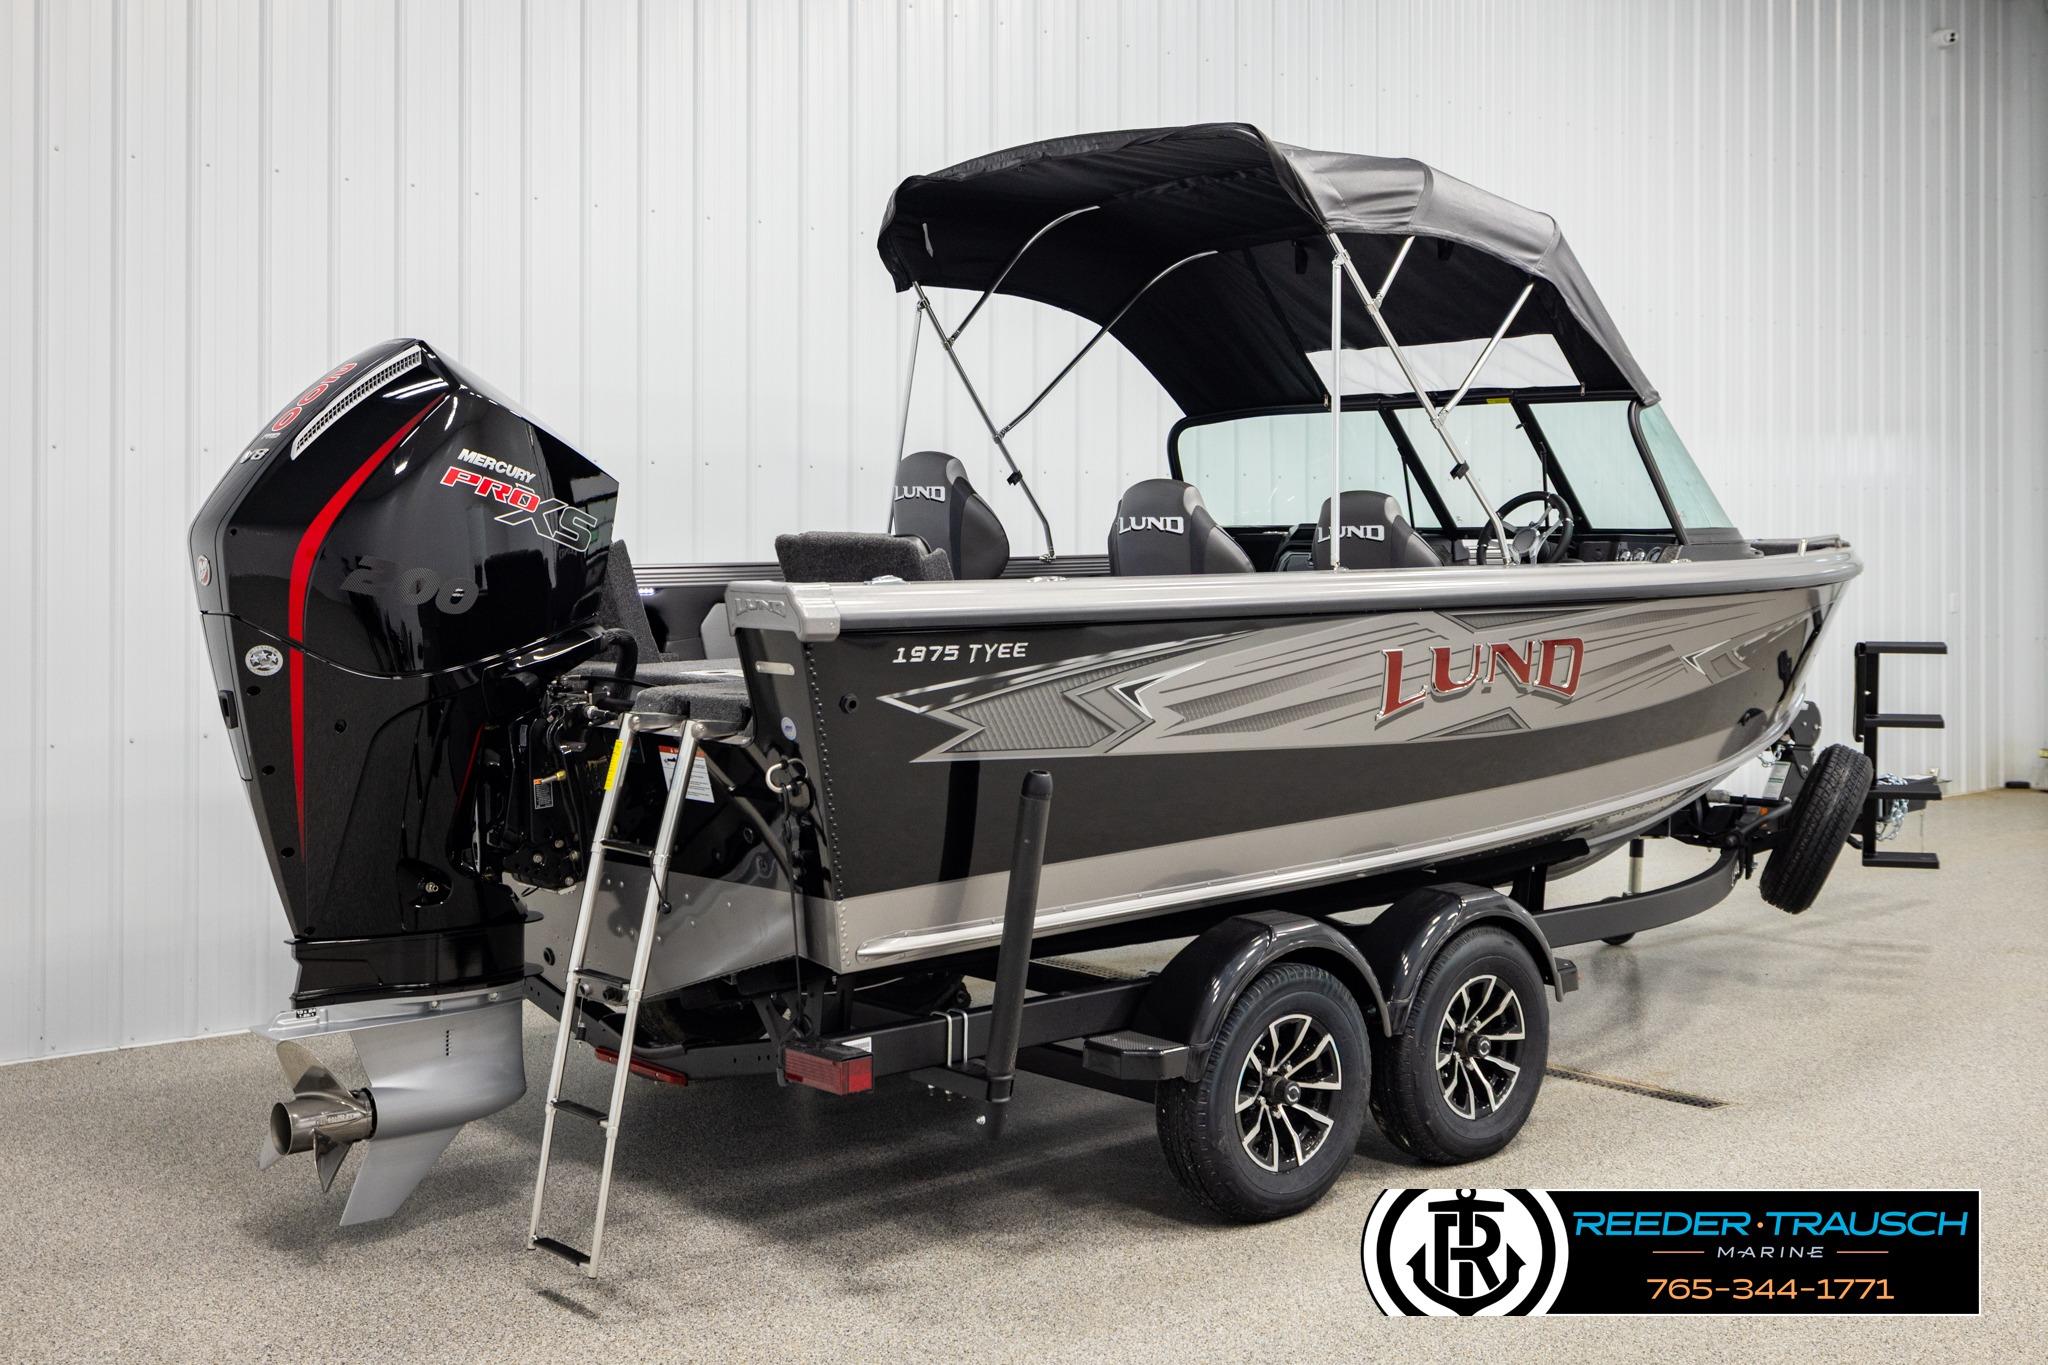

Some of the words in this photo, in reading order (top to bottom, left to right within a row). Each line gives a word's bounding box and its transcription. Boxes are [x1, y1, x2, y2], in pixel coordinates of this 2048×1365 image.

[457, 448, 536, 484] MERCURY
[440, 466, 541, 513] PRO
[894, 485, 946, 503] LUND
[1118, 516, 1185, 535] LUND
[339, 554, 479, 615] 200
[892, 645, 960, 664] 1975
[969, 642, 1029, 664] TYEE
[1375, 637, 1585, 722] LUND
